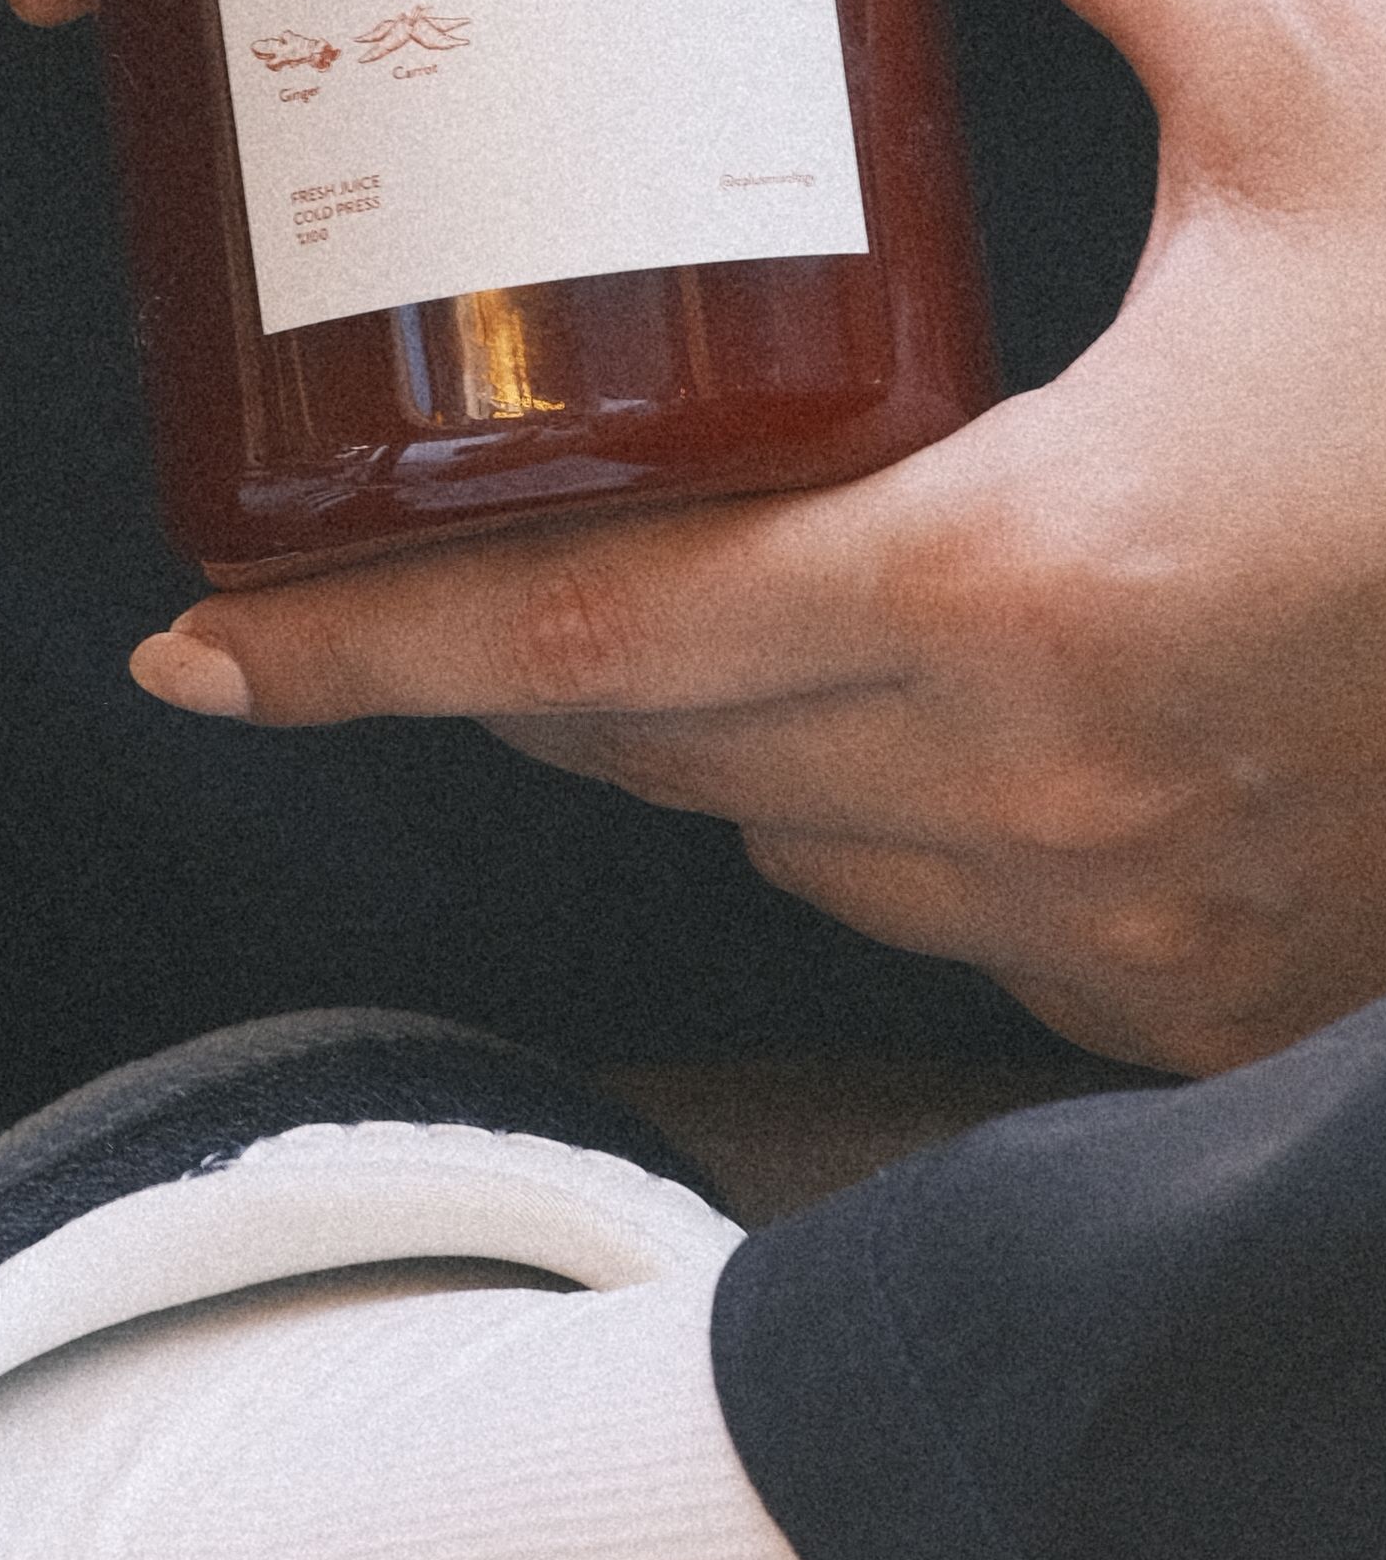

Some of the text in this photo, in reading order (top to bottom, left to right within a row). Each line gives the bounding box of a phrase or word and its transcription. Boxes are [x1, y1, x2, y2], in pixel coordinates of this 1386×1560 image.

[392, 64, 439, 80] Carrot
[278, 86, 321, 104] Ginger
[291, 174, 381, 204] FRESH JUICE
[293, 195, 381, 226] COLD PRESS
